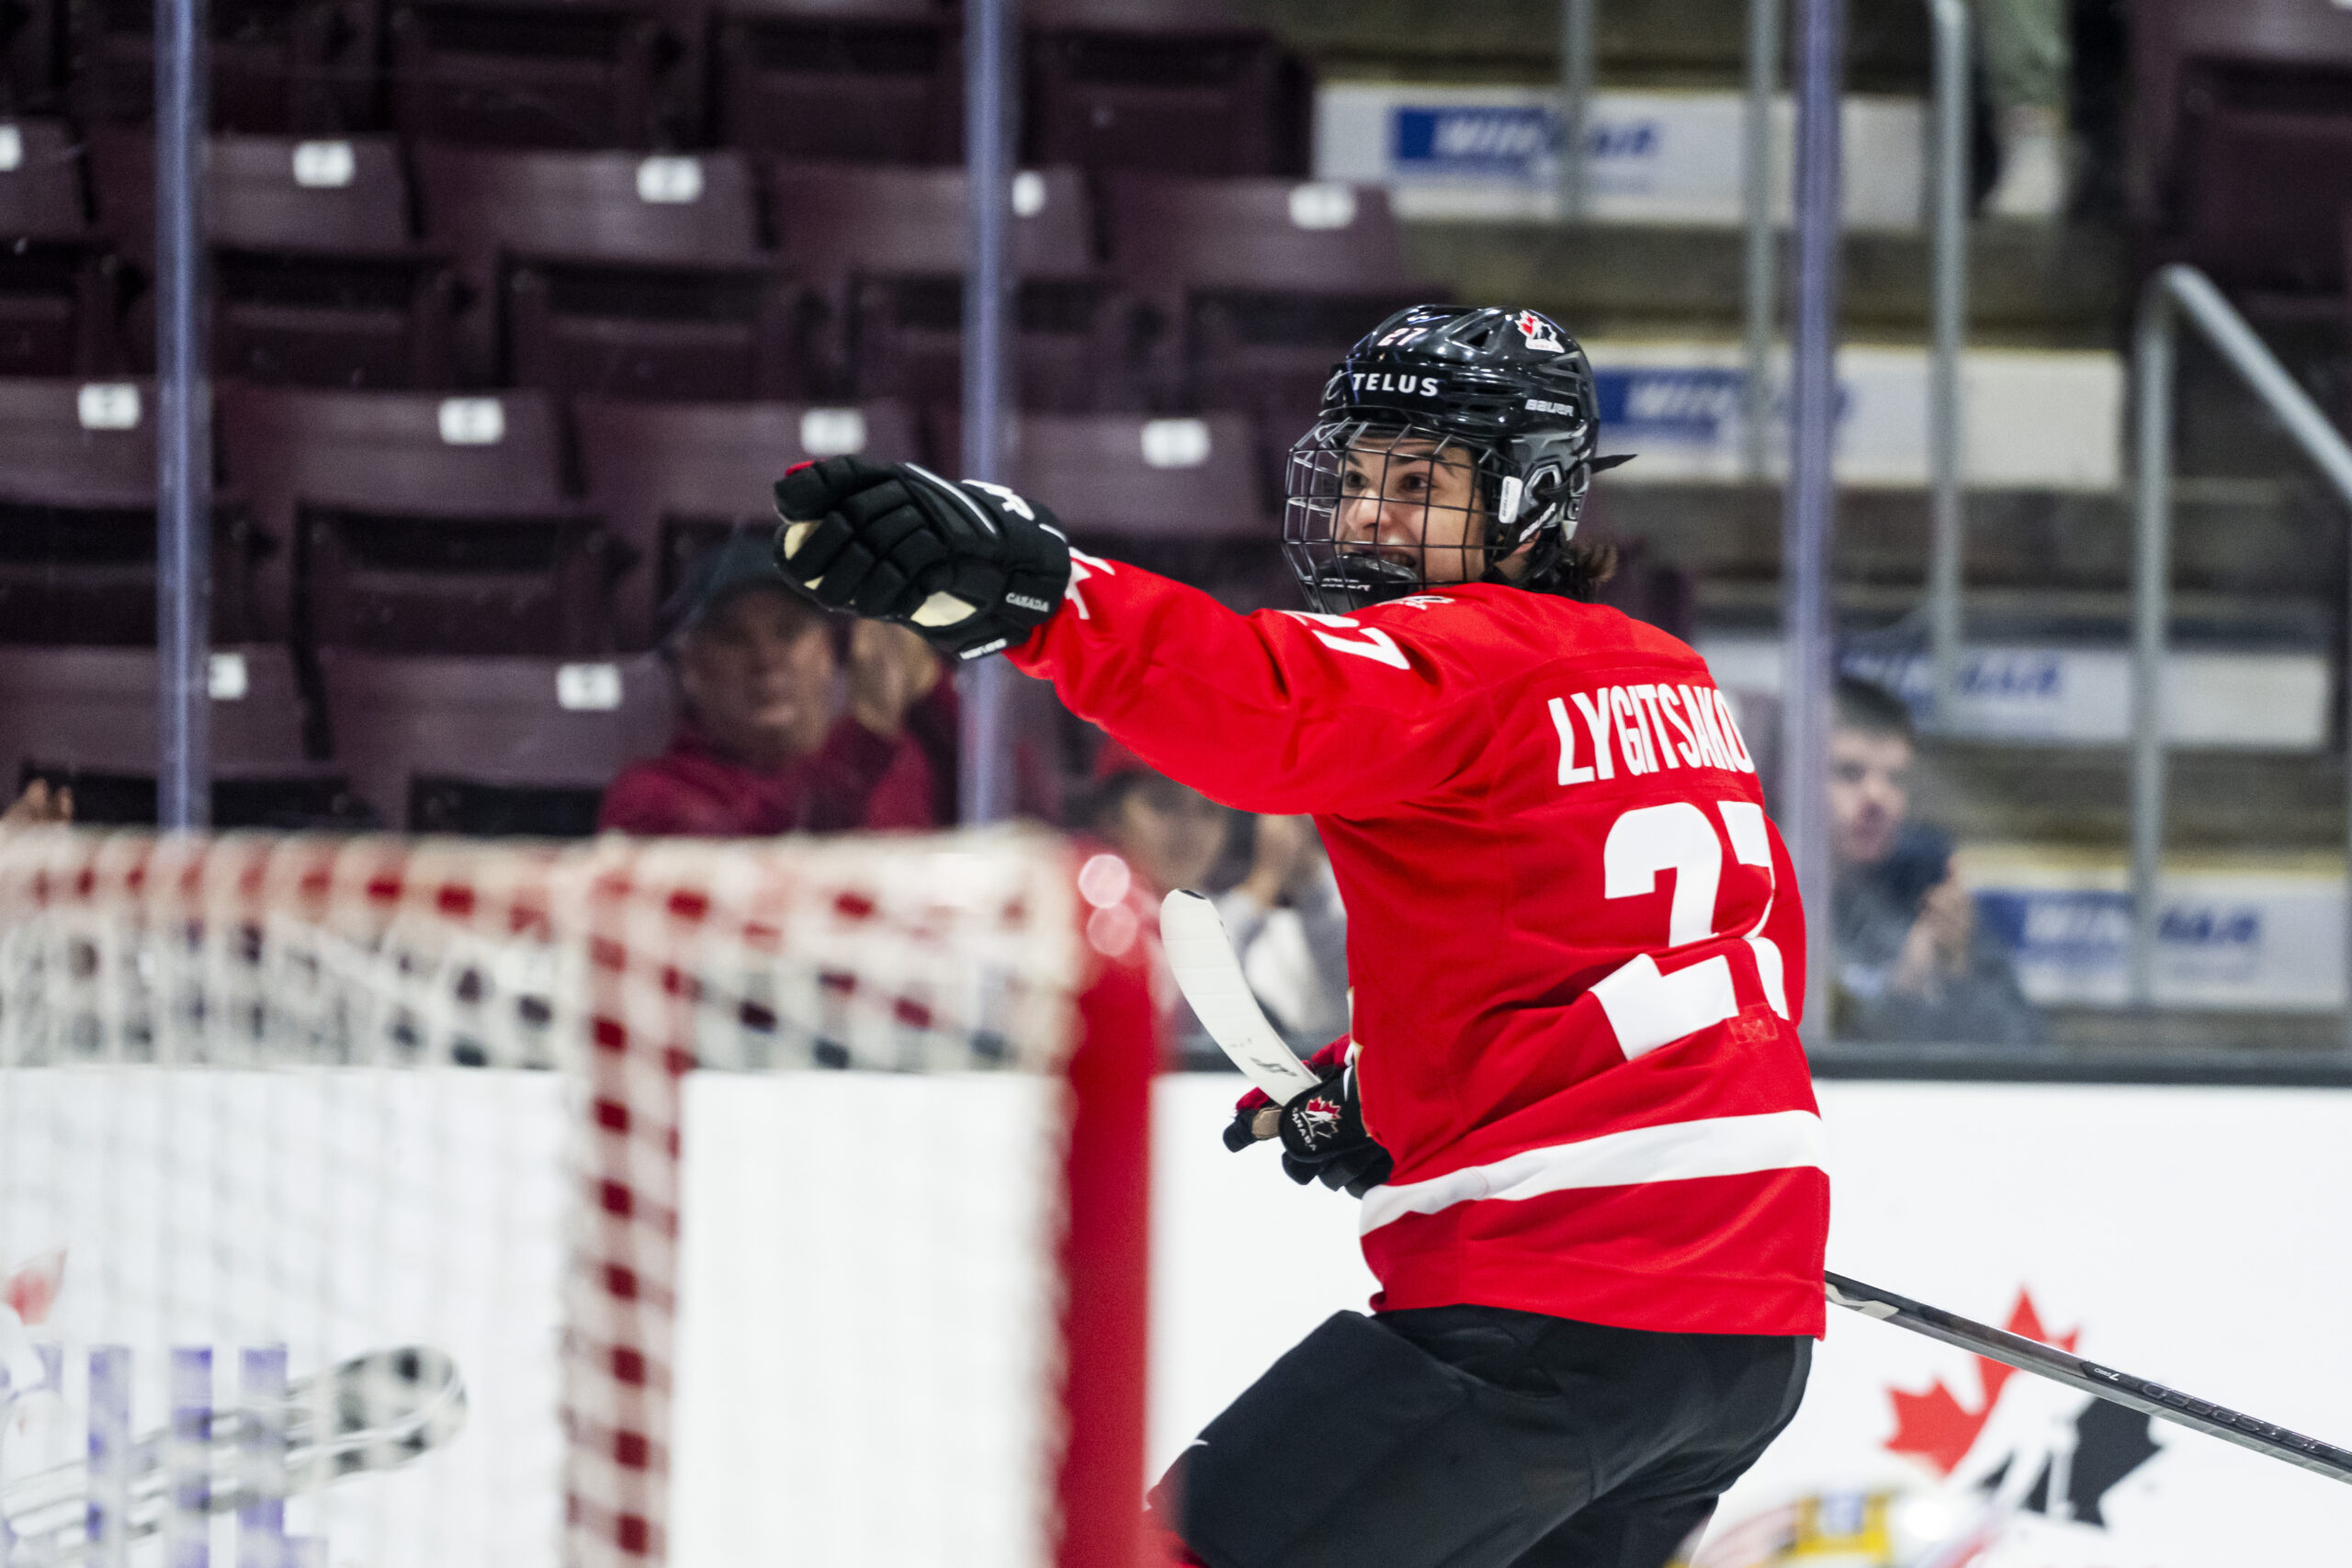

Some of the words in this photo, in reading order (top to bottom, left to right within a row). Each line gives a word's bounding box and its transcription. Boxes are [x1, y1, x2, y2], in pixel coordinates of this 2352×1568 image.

[1377, 327, 1429, 346] 27
[1352, 372, 1439, 397] TELUS
[1524, 399, 1574, 417] BAUER
[1005, 592, 1049, 613] CANADA
[1589, 801, 1791, 1062] 27
[1292, 1107, 1317, 1151] CANADA
